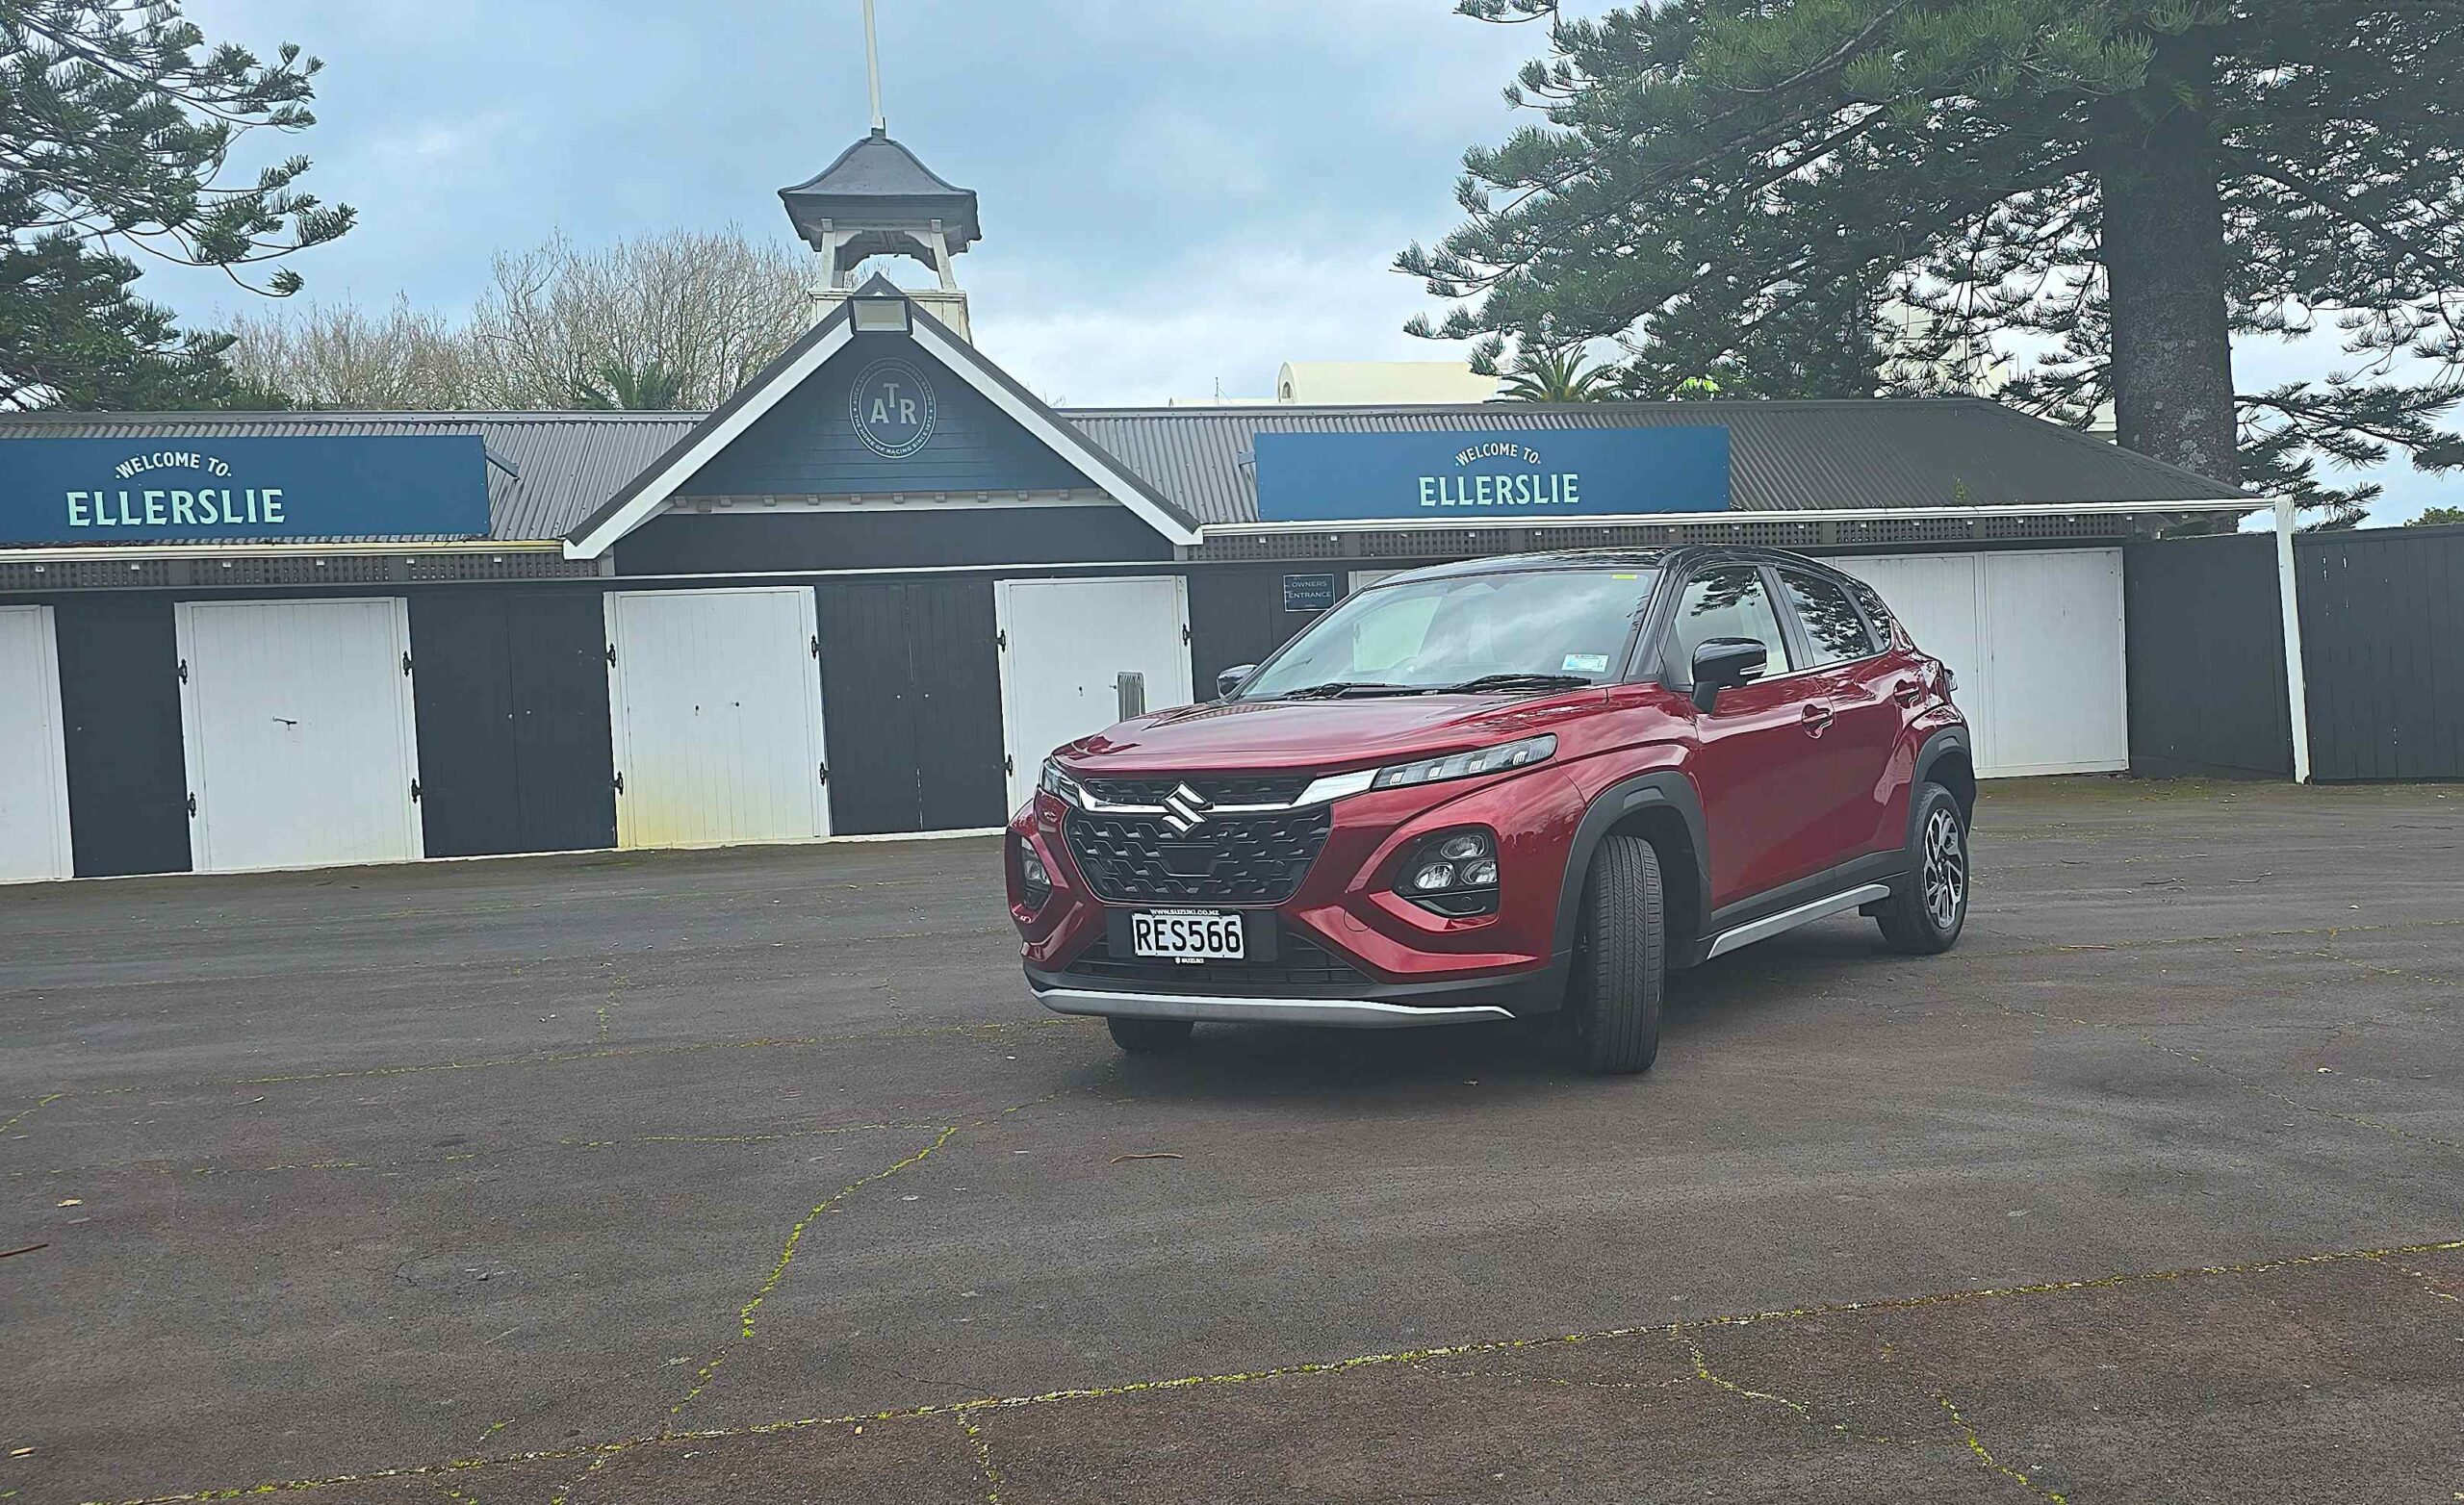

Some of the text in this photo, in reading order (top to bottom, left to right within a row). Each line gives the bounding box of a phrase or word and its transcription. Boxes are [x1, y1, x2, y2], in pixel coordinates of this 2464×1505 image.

[860, 428, 875, 446] HOME
[886, 446, 912, 455] RACING
[912, 432, 928, 448] SINCE
[1455, 443, 1519, 467] WELCOME
[116, 451, 201, 479] WELCOME
[1419, 473, 1580, 507] ELLERSLIE
[66, 488, 286, 526] ELLERSLIE
[1136, 919, 1241, 953] RES566
